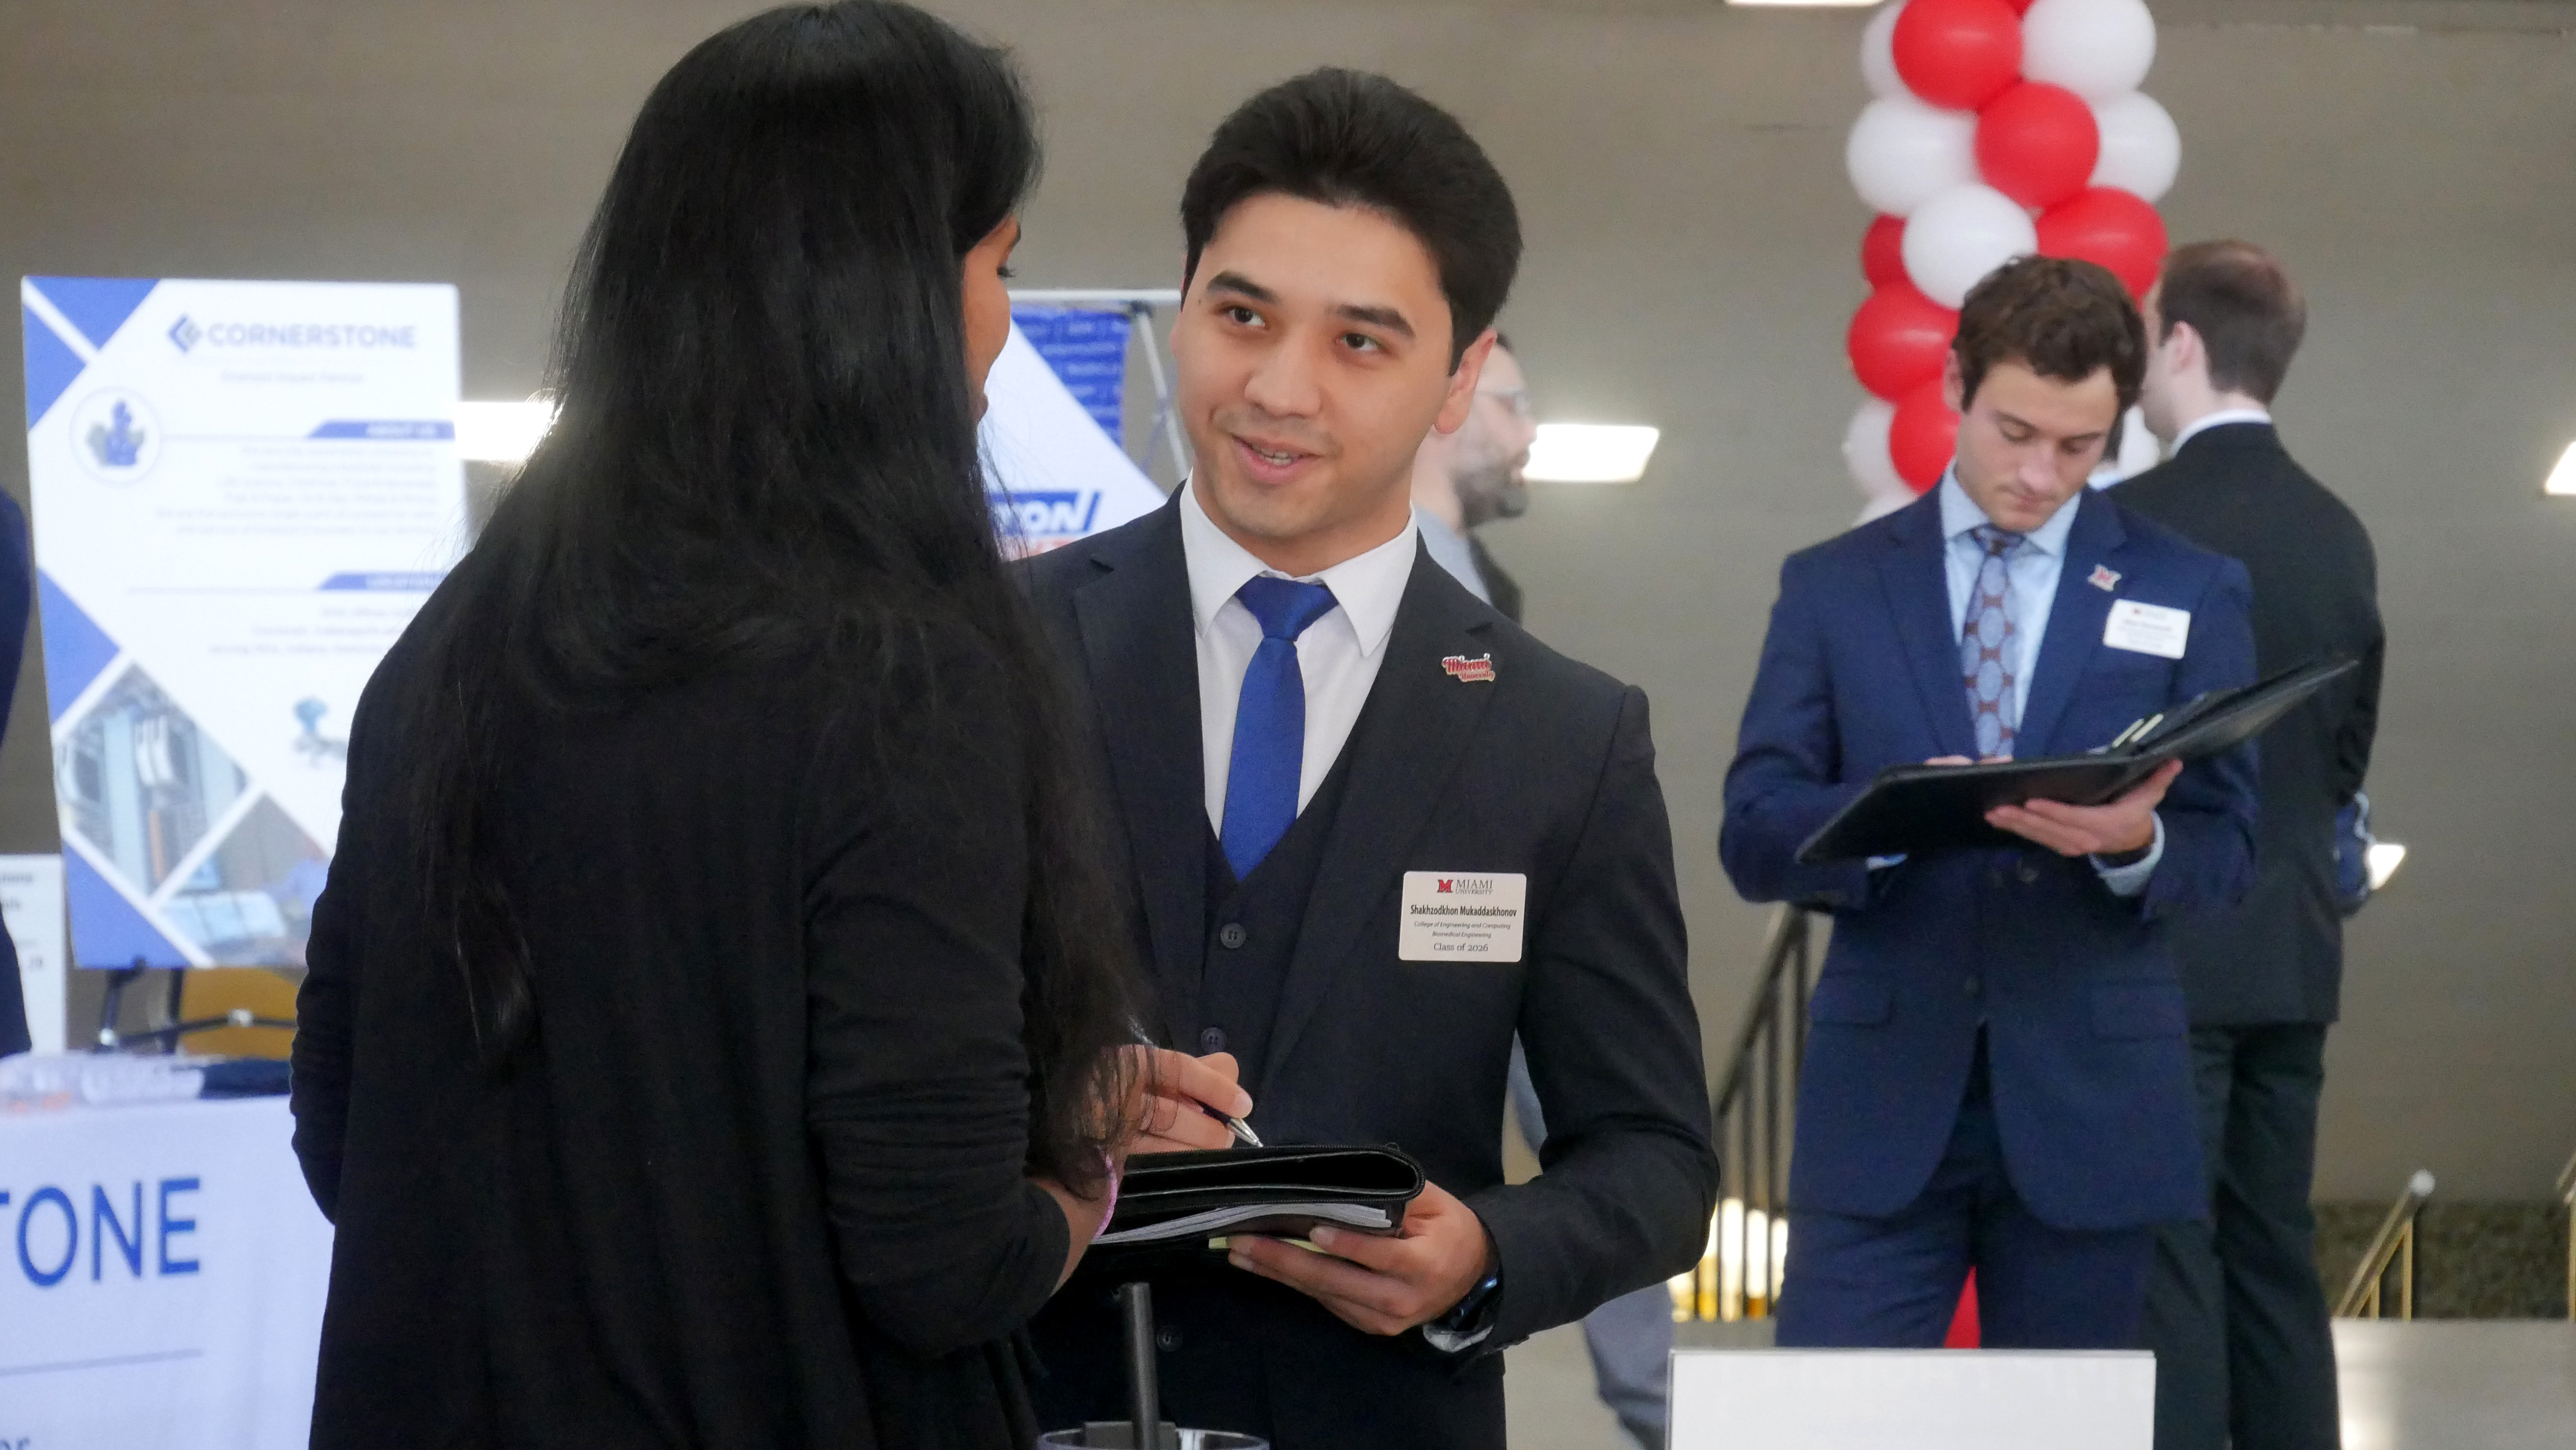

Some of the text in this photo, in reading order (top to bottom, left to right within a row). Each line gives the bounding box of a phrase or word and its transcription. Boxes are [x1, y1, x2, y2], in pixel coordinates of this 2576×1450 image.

[208, 323, 417, 348] CORNERSTONE
[1456, 879, 1493, 889] MIAMI
[1410, 905, 1517, 917] Shakhzodkhon Mukaddaskhonov
[1433, 943, 1489, 952] Class of 2026
[0, 1177, 200, 1289] ONE
